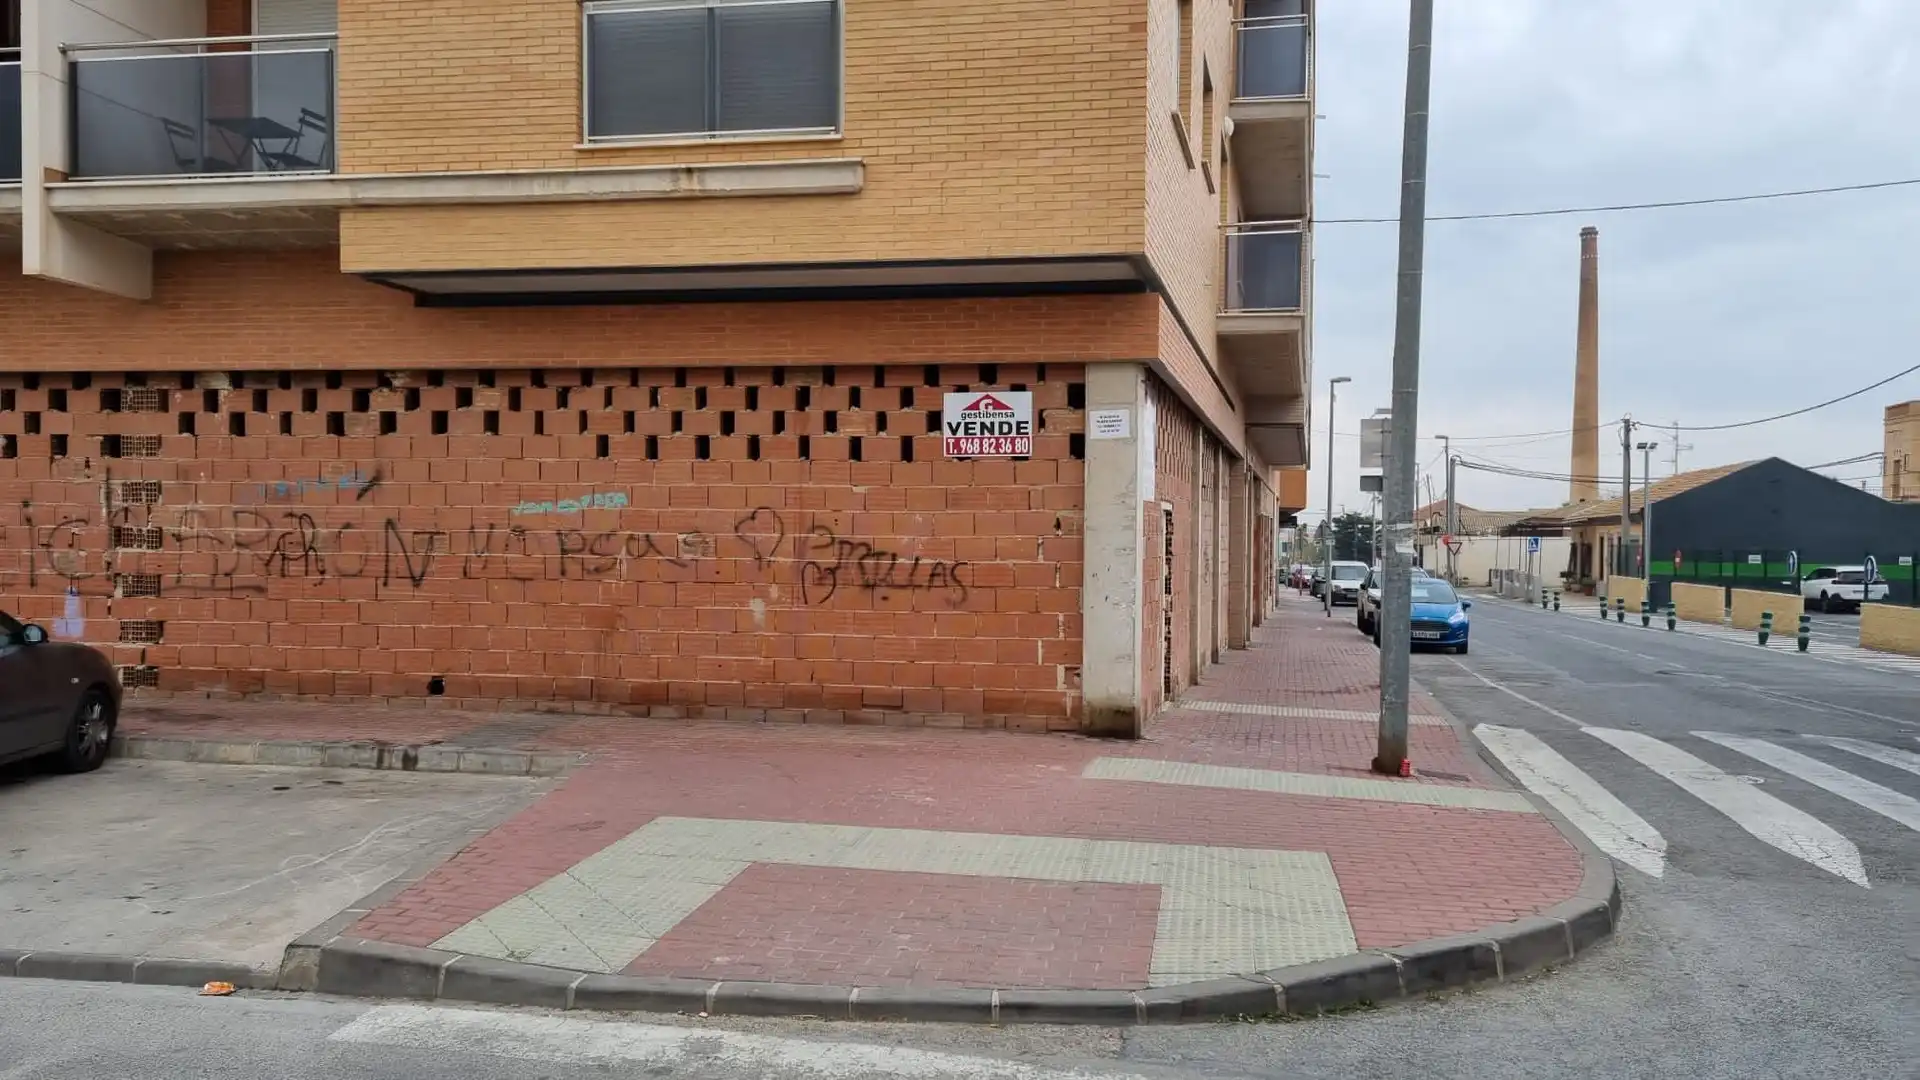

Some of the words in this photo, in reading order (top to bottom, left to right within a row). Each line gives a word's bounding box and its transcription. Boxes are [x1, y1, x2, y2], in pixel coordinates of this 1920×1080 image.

[961, 411, 1015, 420] gestibensa
[947, 421, 1029, 435] VENDE
[947, 438, 957, 453] T.
[960, 438, 980, 453] 968
[982, 438, 996, 453] 82
[999, 438, 1012, 453] 36
[1015, 438, 1029, 453] 80
